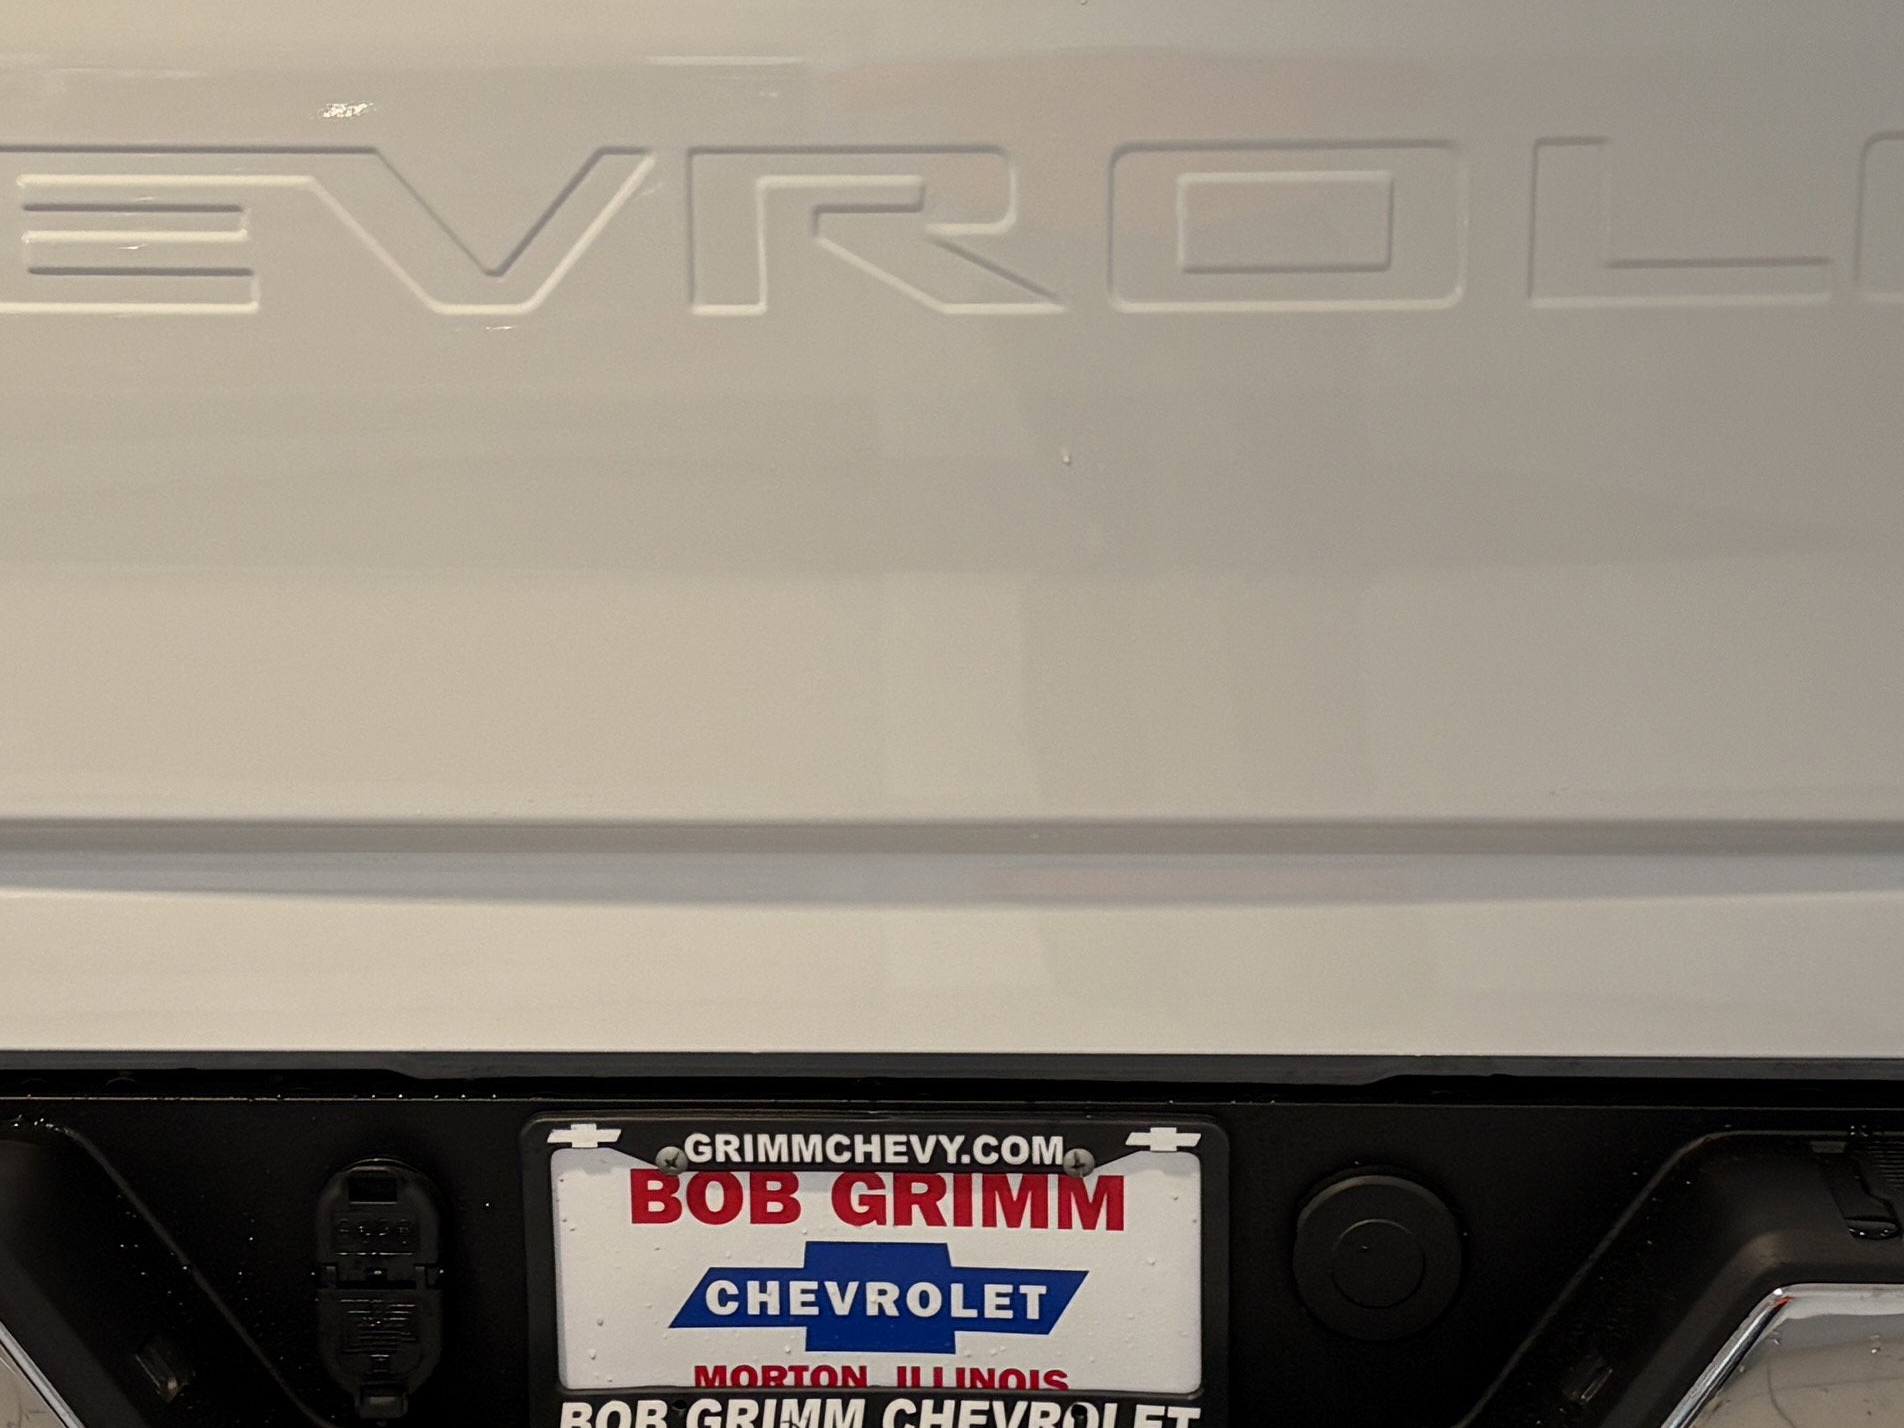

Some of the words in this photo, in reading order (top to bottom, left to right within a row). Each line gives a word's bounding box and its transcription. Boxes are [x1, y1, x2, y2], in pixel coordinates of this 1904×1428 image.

[683, 1132, 1064, 1166] GRIMMCHEVY.COM
[630, 1169, 802, 1225] BOB
[831, 1172, 1125, 1232] GRIMM
[704, 1279, 1050, 1321] CHEVROLET
[694, 1365, 868, 1388] MORTON
